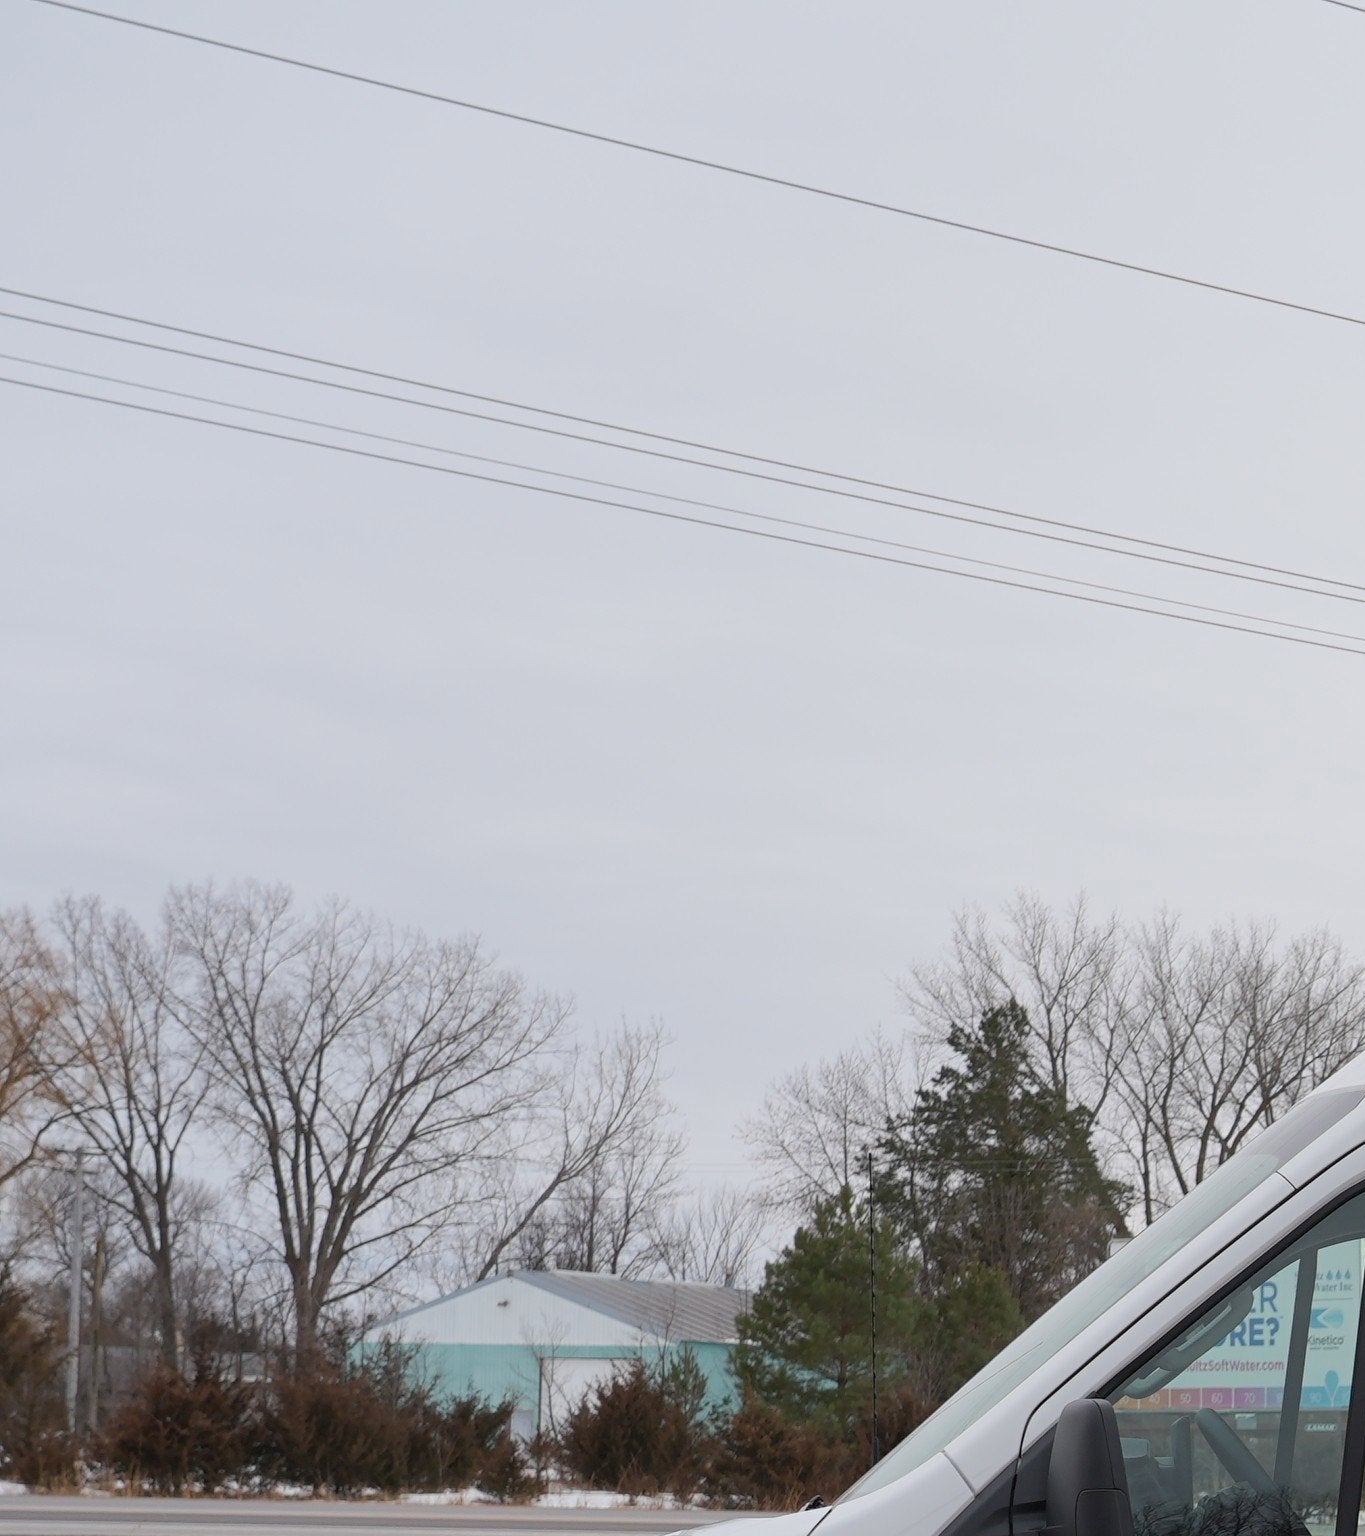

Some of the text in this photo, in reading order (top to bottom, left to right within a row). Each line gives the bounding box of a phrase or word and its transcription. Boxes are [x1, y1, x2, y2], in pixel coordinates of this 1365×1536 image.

[1215, 1316, 1281, 1347] RE?
[1186, 1359, 1285, 1372] ultzSoftWater.com
[1180, 1393, 1192, 1404] 50
[1211, 1393, 1223, 1404] 60
[1244, 1392, 1256, 1403] 70
